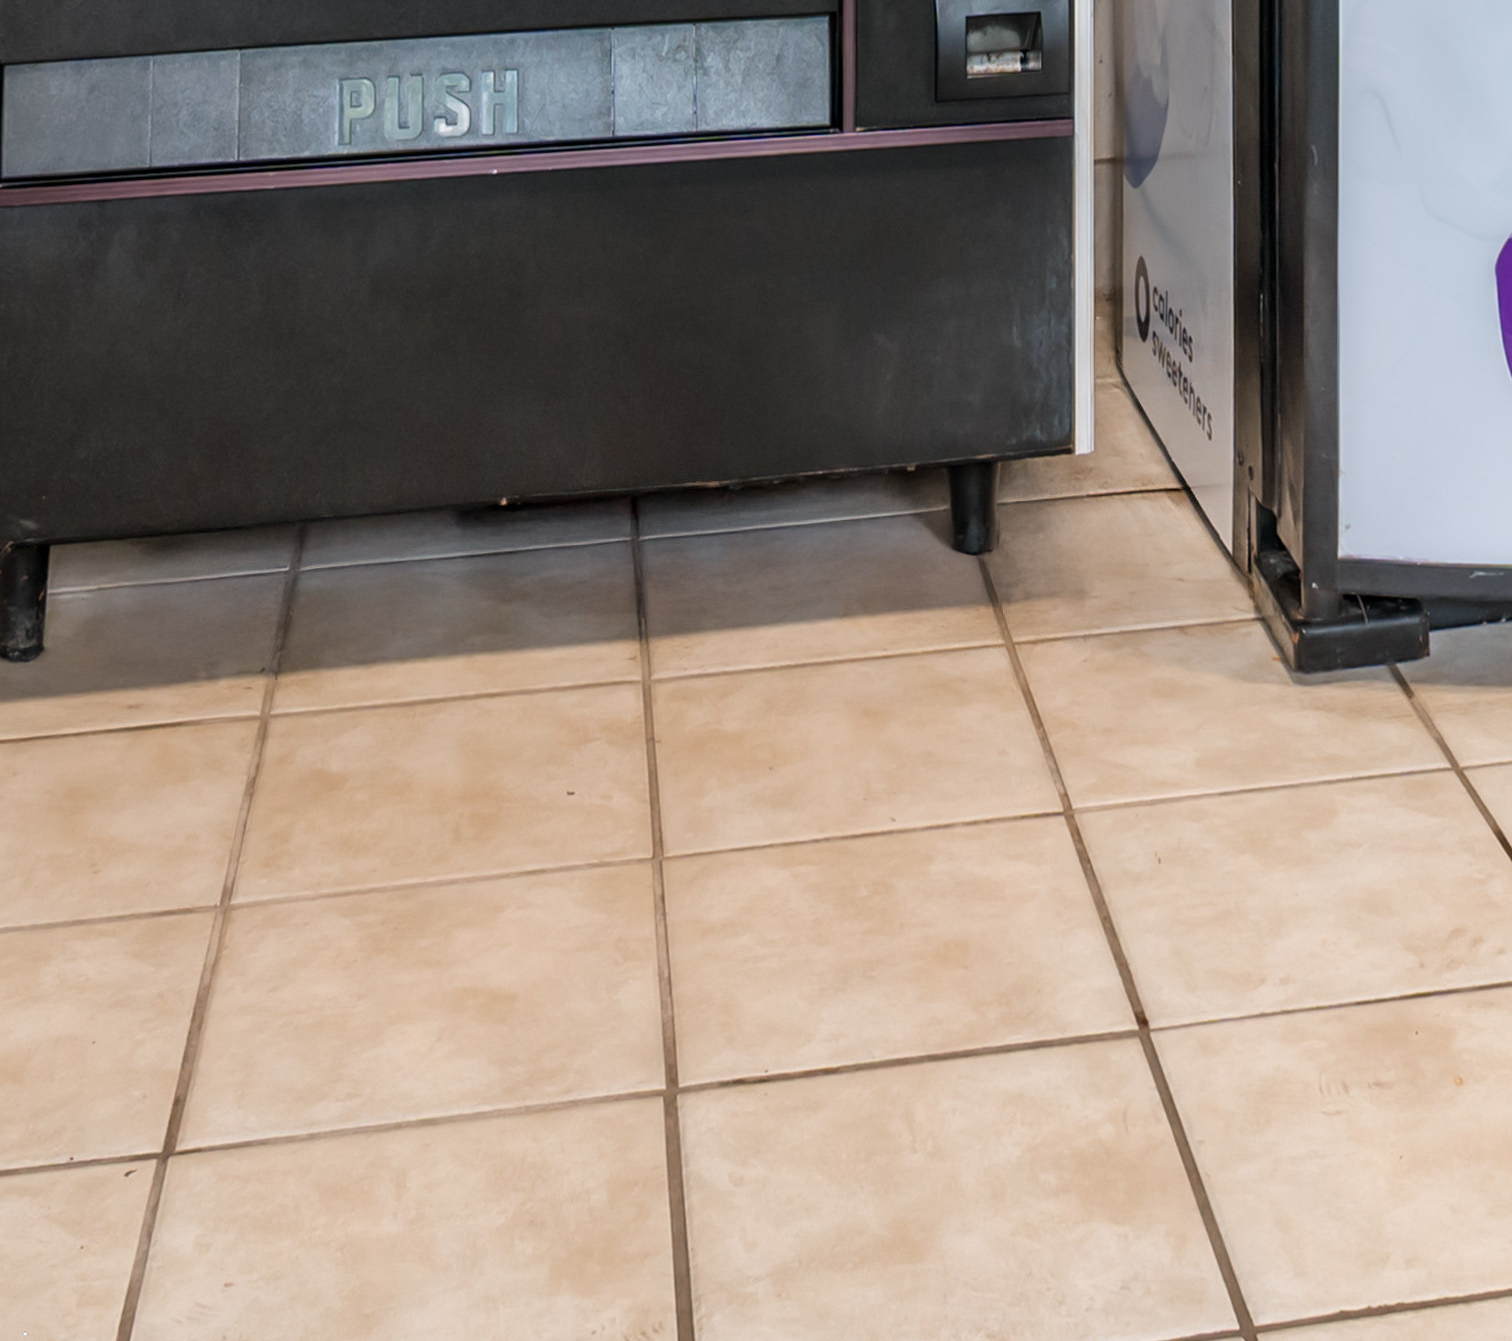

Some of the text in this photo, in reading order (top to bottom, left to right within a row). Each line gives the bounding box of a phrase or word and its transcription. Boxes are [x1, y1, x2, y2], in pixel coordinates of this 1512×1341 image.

[336, 69, 522, 146] PUSH
[1152, 285, 1194, 364] calories
[1151, 329, 1213, 442] sweeteners
